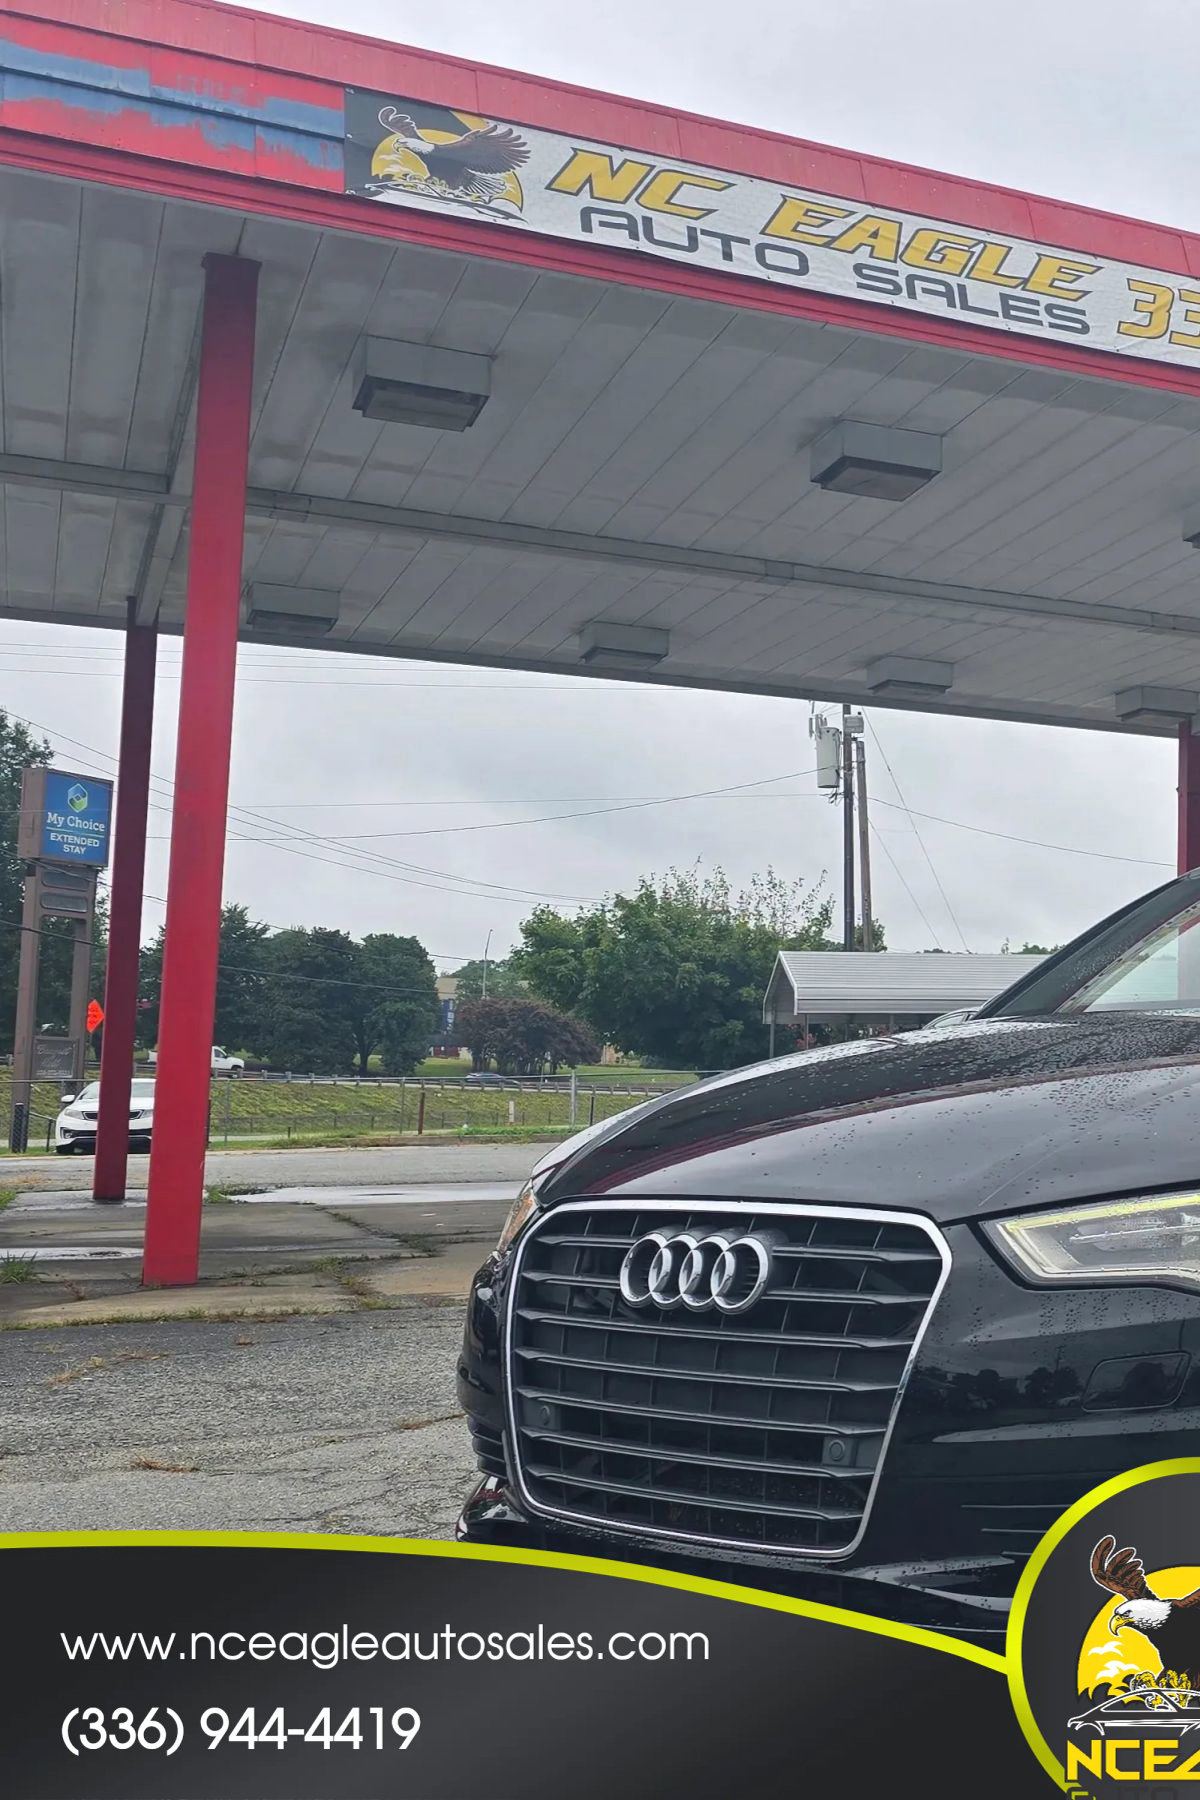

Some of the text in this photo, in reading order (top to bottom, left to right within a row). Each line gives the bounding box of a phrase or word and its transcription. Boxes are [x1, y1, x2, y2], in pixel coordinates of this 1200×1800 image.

[545, 146, 1104, 302] NC EAGLE
[580, 206, 1090, 336] AUTO SALES
[46, 812, 105, 832] My Choice
[50, 832, 100, 847] EXTENDED
[63, 844, 87, 854] STAY
